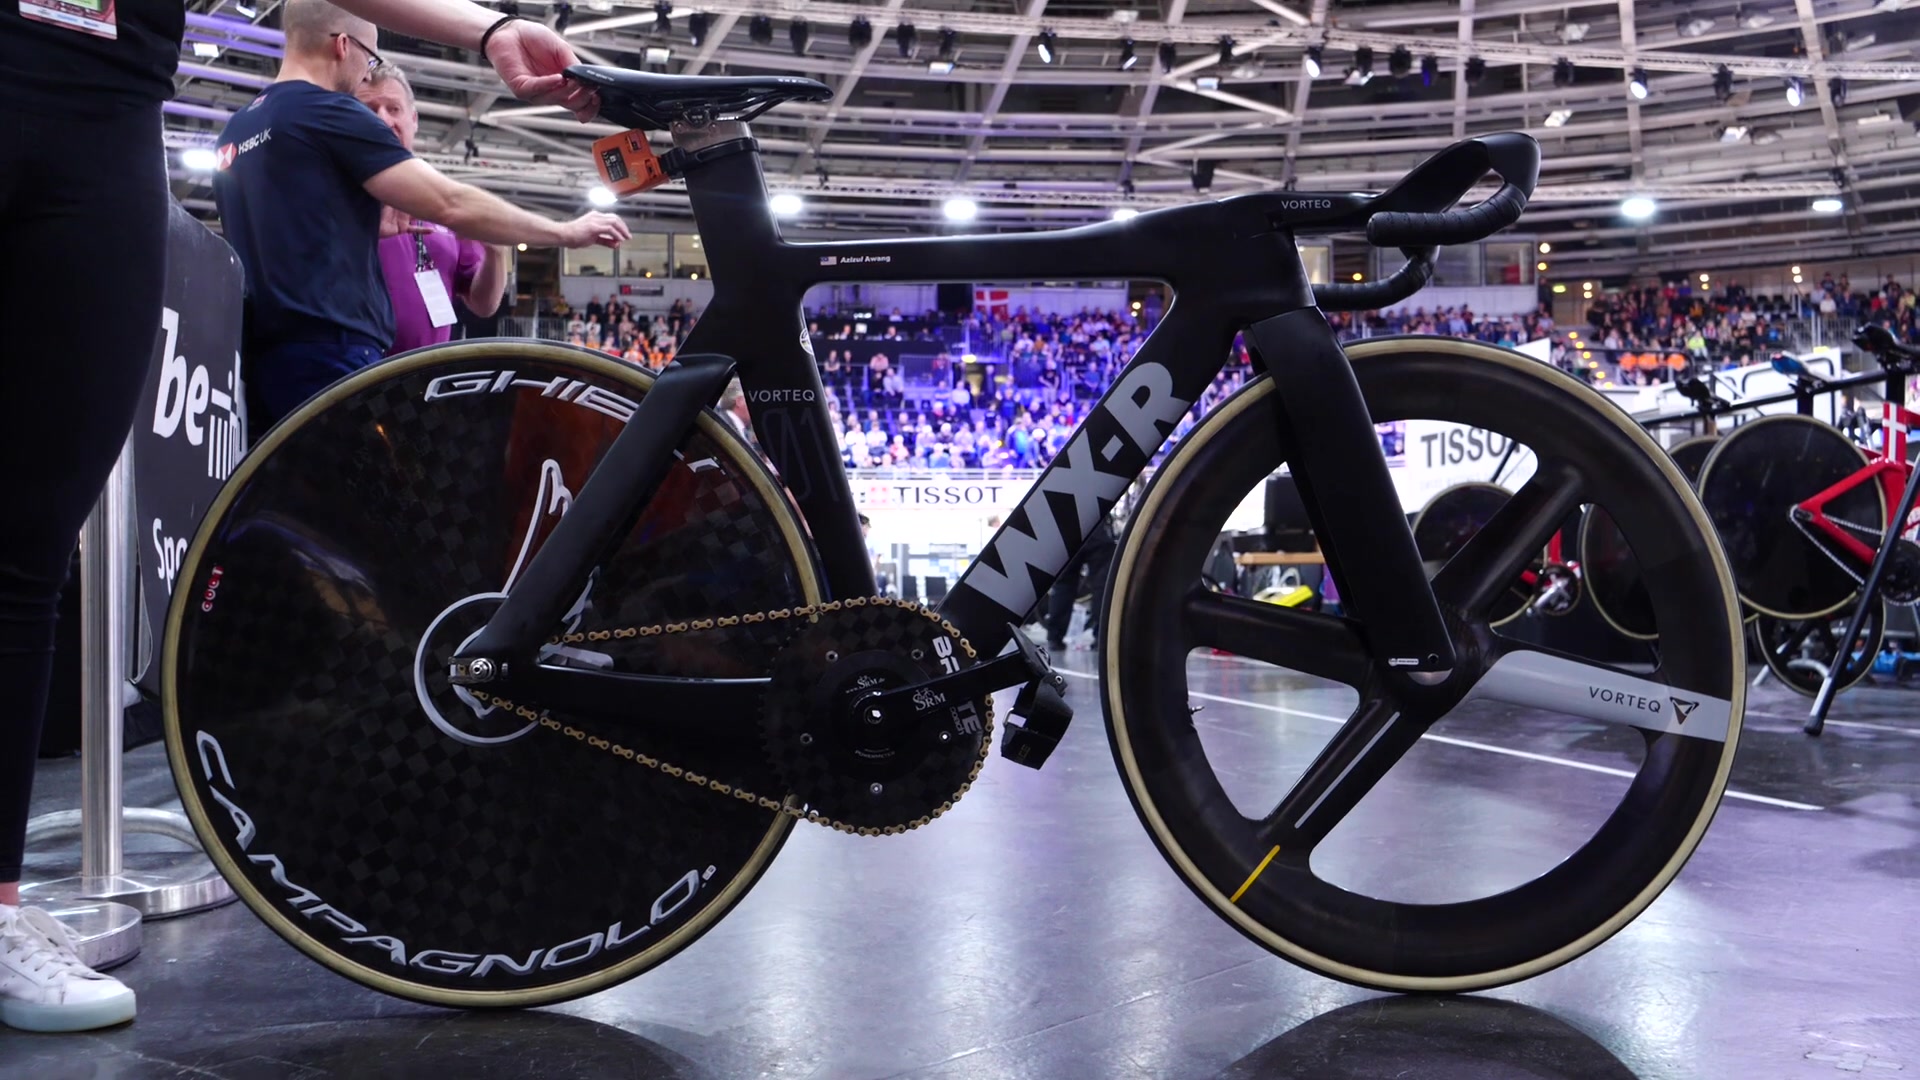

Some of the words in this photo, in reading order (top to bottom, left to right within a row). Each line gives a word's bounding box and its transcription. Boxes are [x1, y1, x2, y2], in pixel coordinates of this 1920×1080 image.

[238, 134, 260, 155] HSBC
[260, 128, 272, 144] UK
[1281, 199, 1332, 210] VORTEQ
[864, 255, 891, 263] Awang
[153, 307, 210, 445] be
[749, 389, 816, 403] VORTEQ
[1420, 427, 1512, 468] TISSO
[893, 486, 1003, 504] TISSOT
[963, 361, 1191, 619] WX-R
[912, 687, 946, 711] SRM
[1588, 686, 1662, 714] VORTEQ
[196, 730, 699, 978] CAMPAGNOLO
